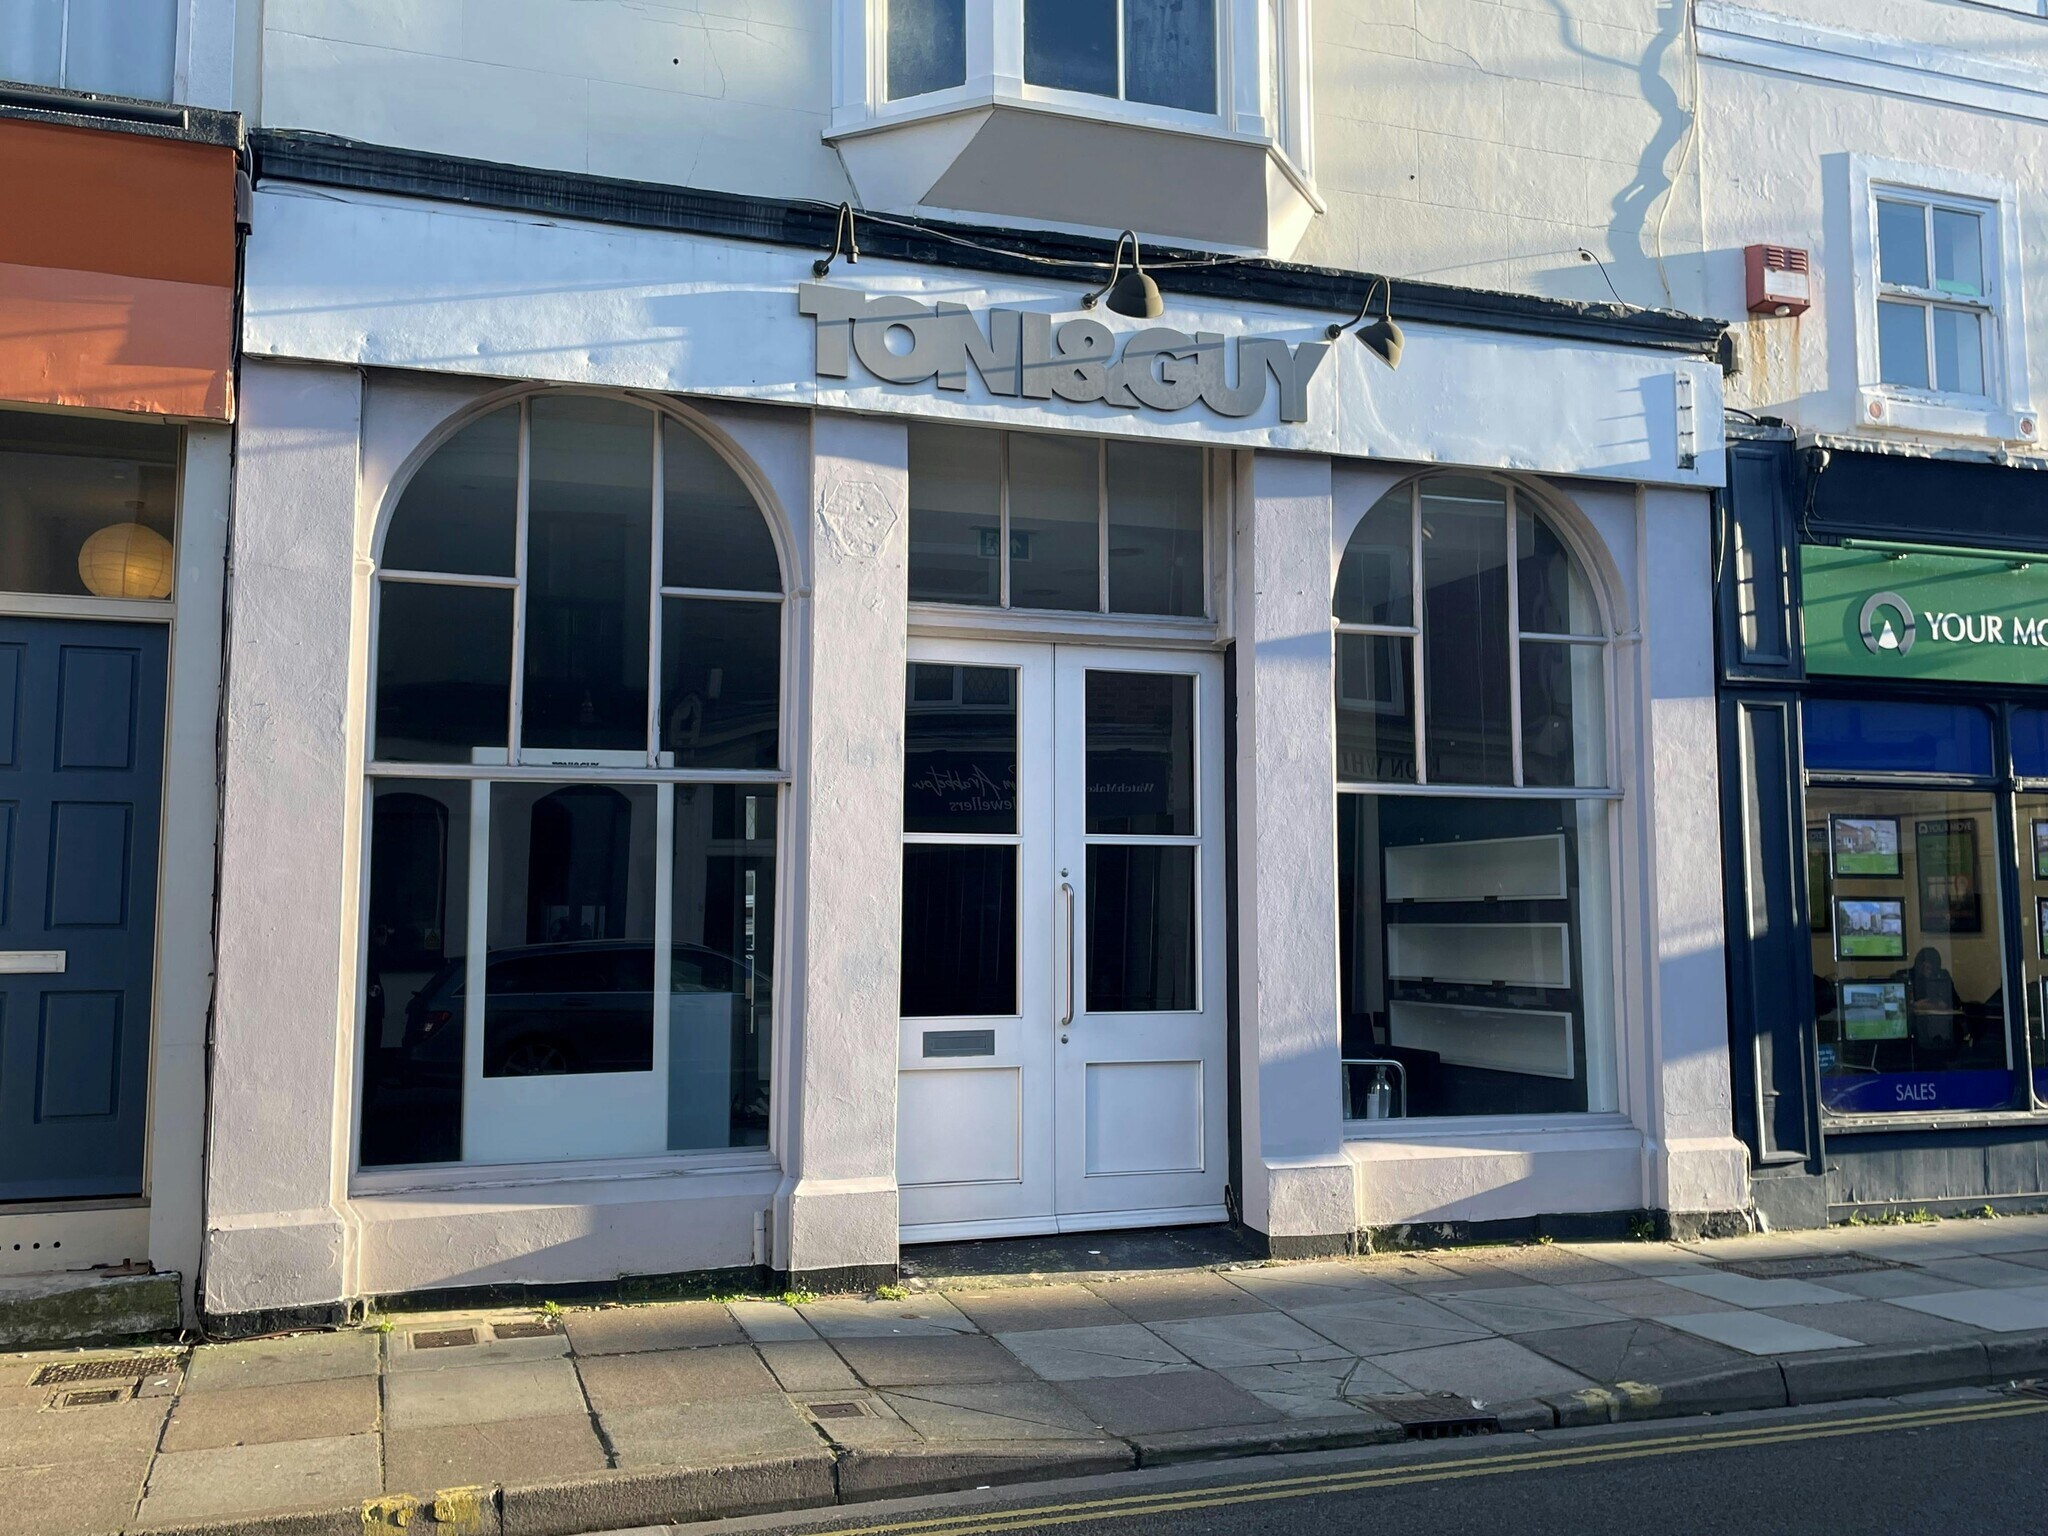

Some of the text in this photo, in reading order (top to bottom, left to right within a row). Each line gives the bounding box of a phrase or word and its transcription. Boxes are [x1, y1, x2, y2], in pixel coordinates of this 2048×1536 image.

[799, 283, 1330, 423] TONI&GUY
[1923, 611, 2006, 645] YOUR
[1895, 1083, 1936, 1101] SALES
